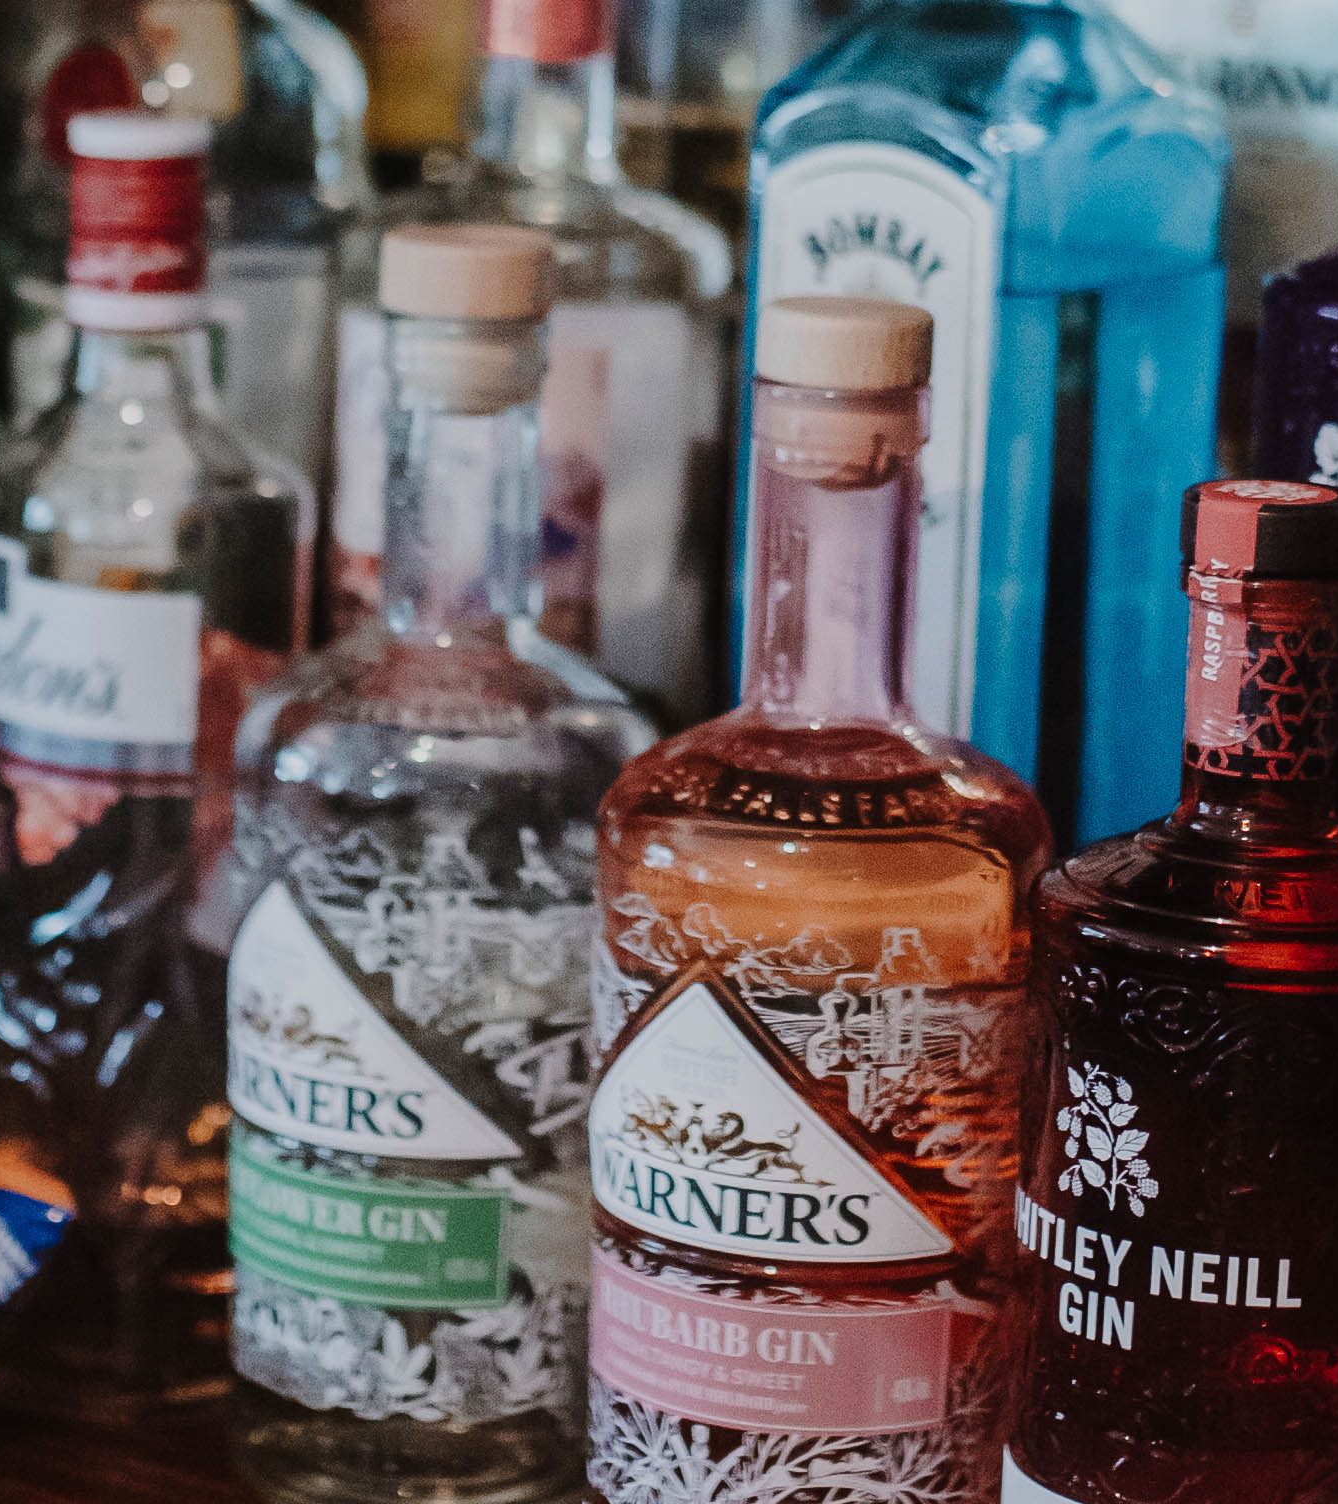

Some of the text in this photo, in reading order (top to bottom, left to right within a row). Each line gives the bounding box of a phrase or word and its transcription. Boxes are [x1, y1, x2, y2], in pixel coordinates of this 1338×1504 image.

[806, 213, 944, 294] BOMBAY
[241, 1054, 424, 1139] RNER'S
[368, 1205, 449, 1242] GIN
[603, 1145, 871, 1246] WARNER'S
[1150, 1246, 1302, 1308] NEILL
[757, 1325, 838, 1367] GIN
[1058, 1282, 1135, 1351] GIN
